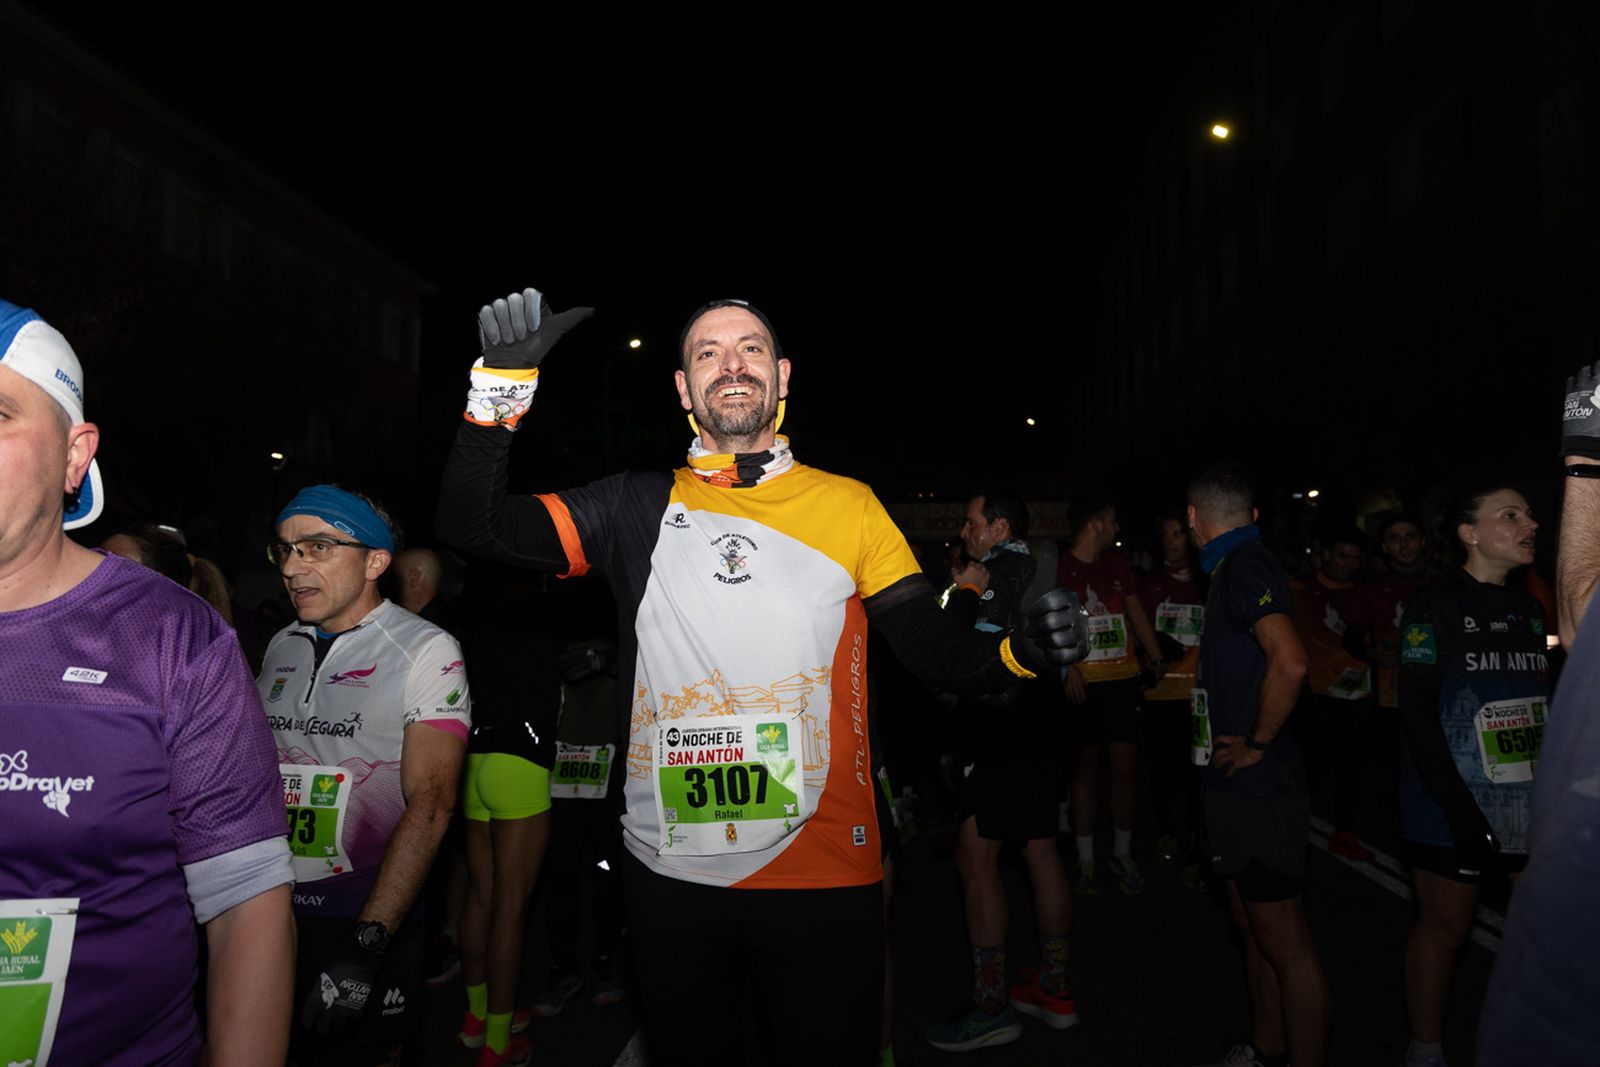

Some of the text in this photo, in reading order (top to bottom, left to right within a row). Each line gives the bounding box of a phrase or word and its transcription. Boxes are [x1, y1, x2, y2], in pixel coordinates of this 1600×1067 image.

[55, 369, 82, 401] BROO
[713, 572, 752, 585] PELIGROS
[1466, 652, 1501, 671] SAN
[295, 720, 305, 730] DE
[304, 716, 355, 738] SEGURA
[682, 731, 742, 747] NOCHE DE
[668, 745, 743, 765] SAN ANTÓN
[560, 761, 601, 780] 8608
[289, 778, 302, 790] DE
[685, 765, 769, 808] 3107
[715, 809, 743, 819] Rafael
